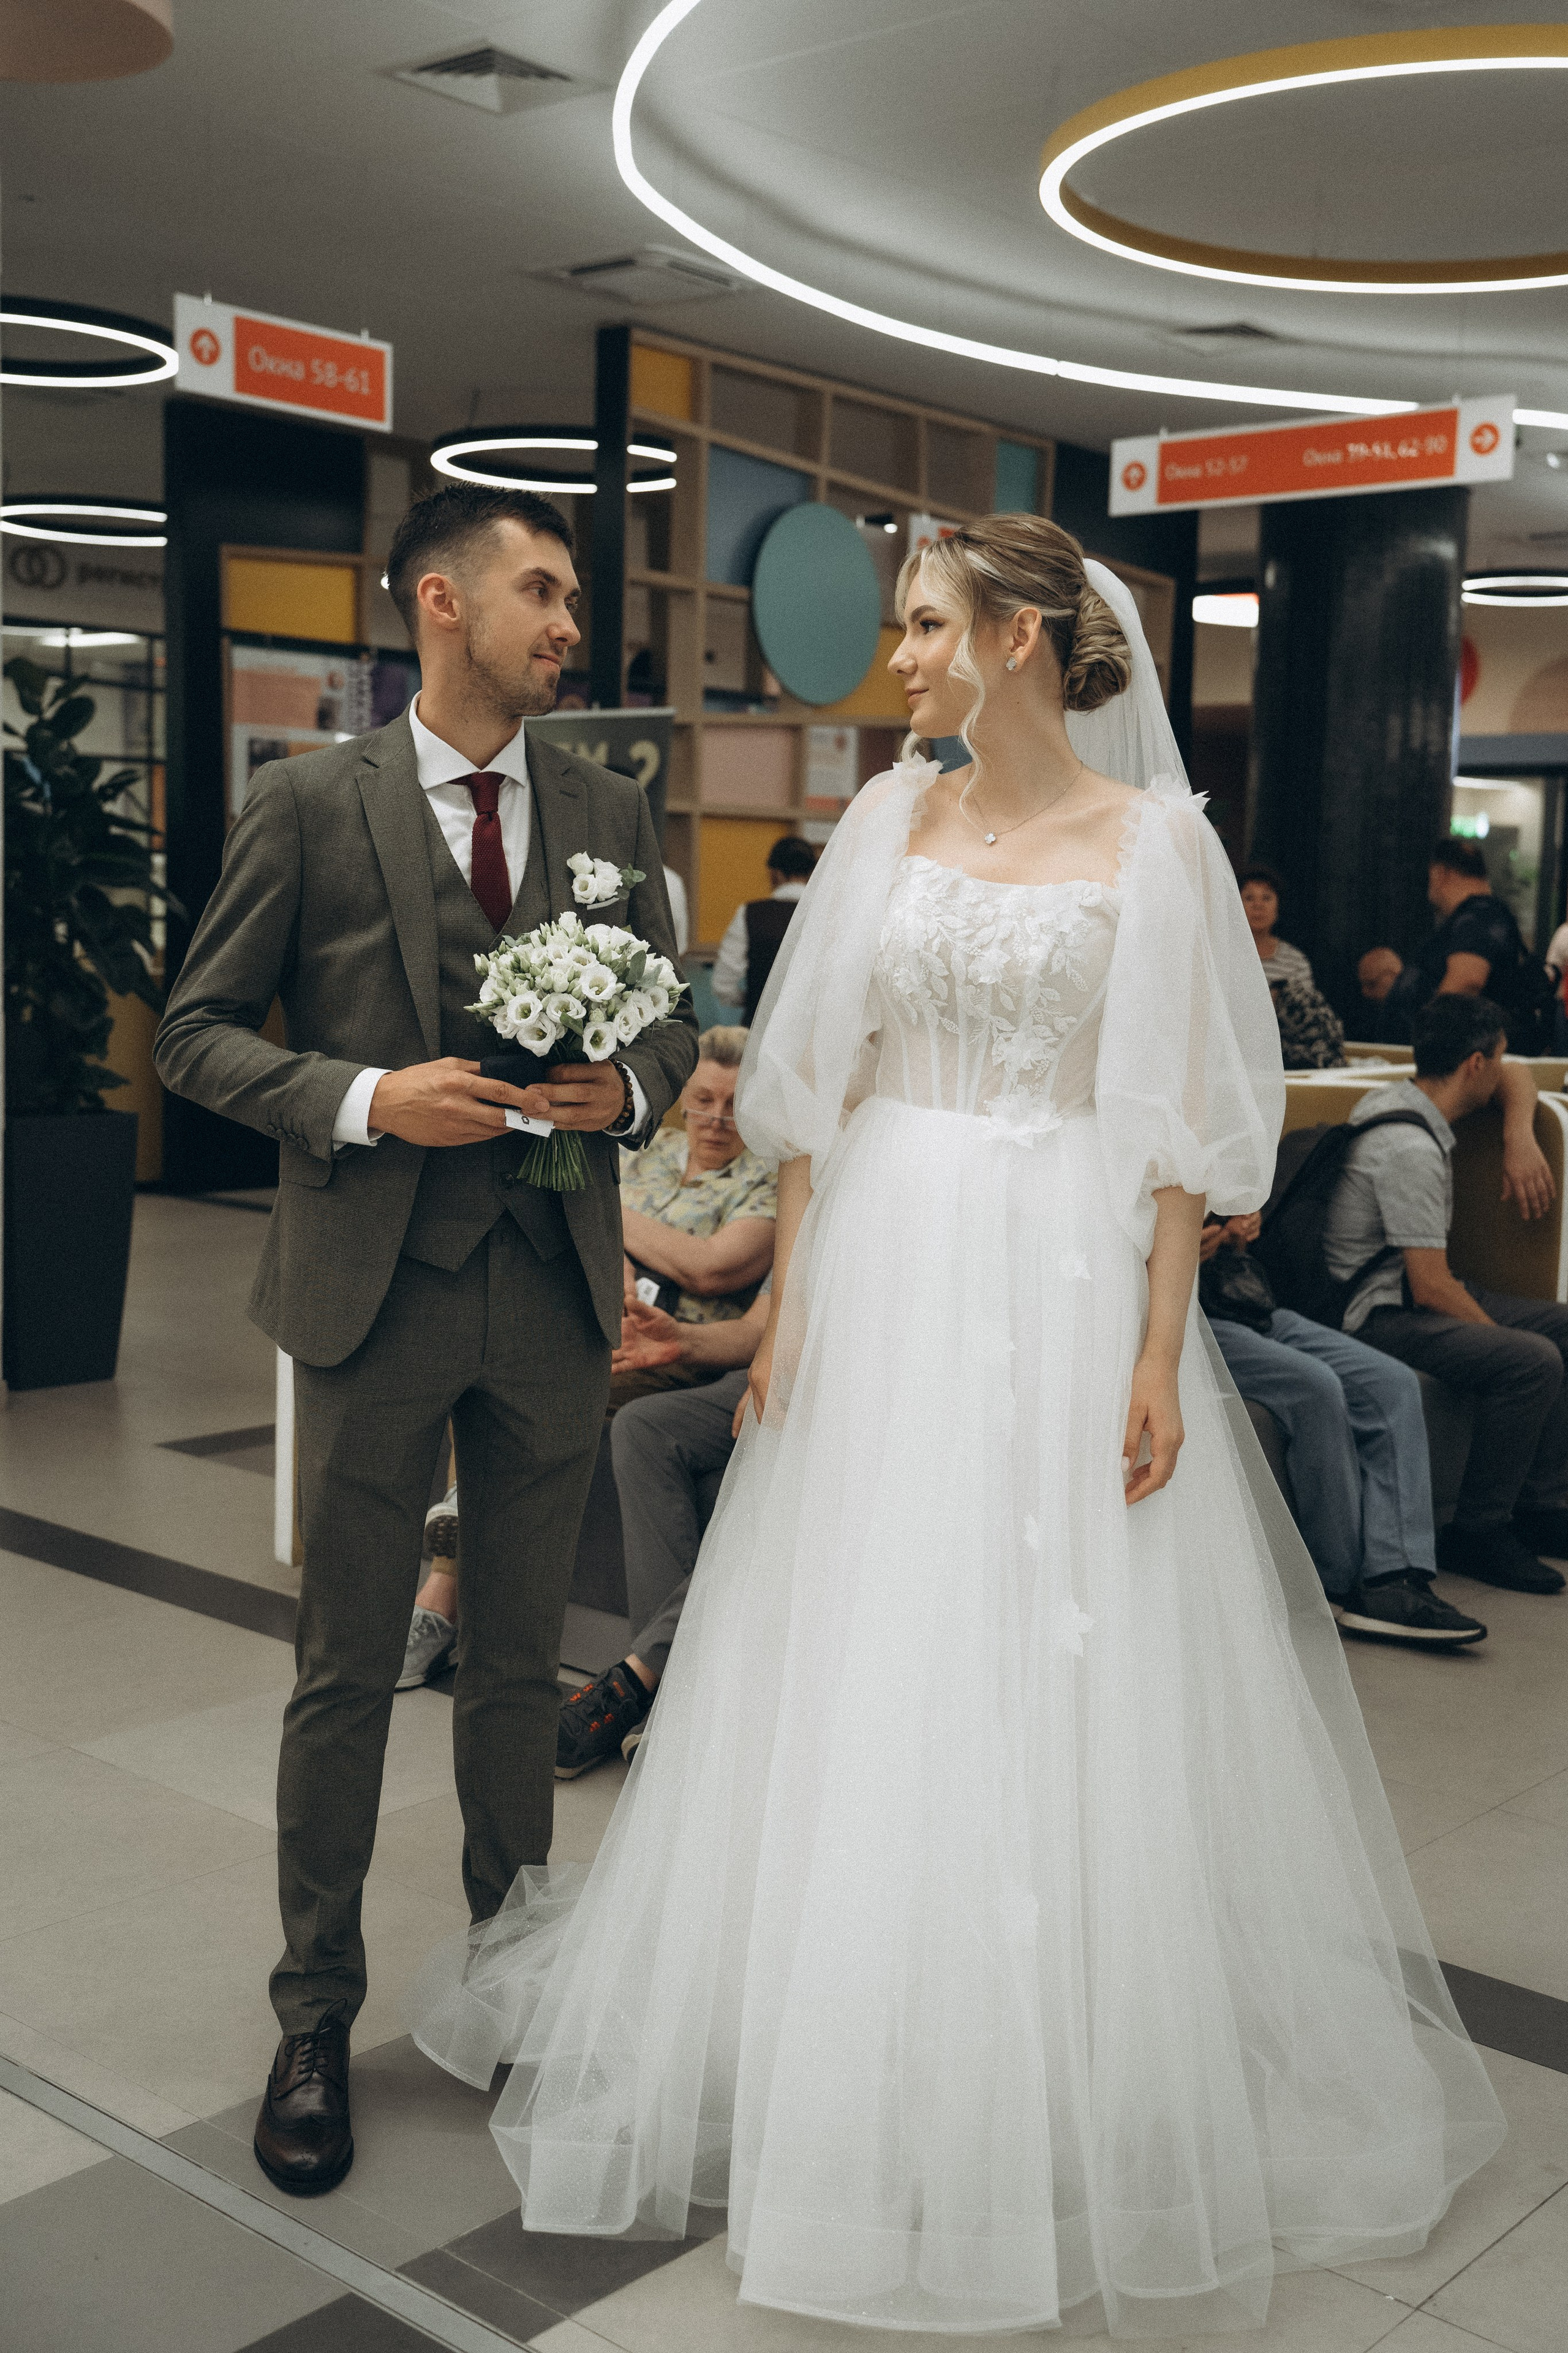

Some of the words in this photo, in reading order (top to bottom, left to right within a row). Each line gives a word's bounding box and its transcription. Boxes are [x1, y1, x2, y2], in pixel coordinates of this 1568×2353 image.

[248, 345, 305, 382] Окна
[311, 358, 371, 396] 58-61
[1165, 463, 1202, 482] Окна
